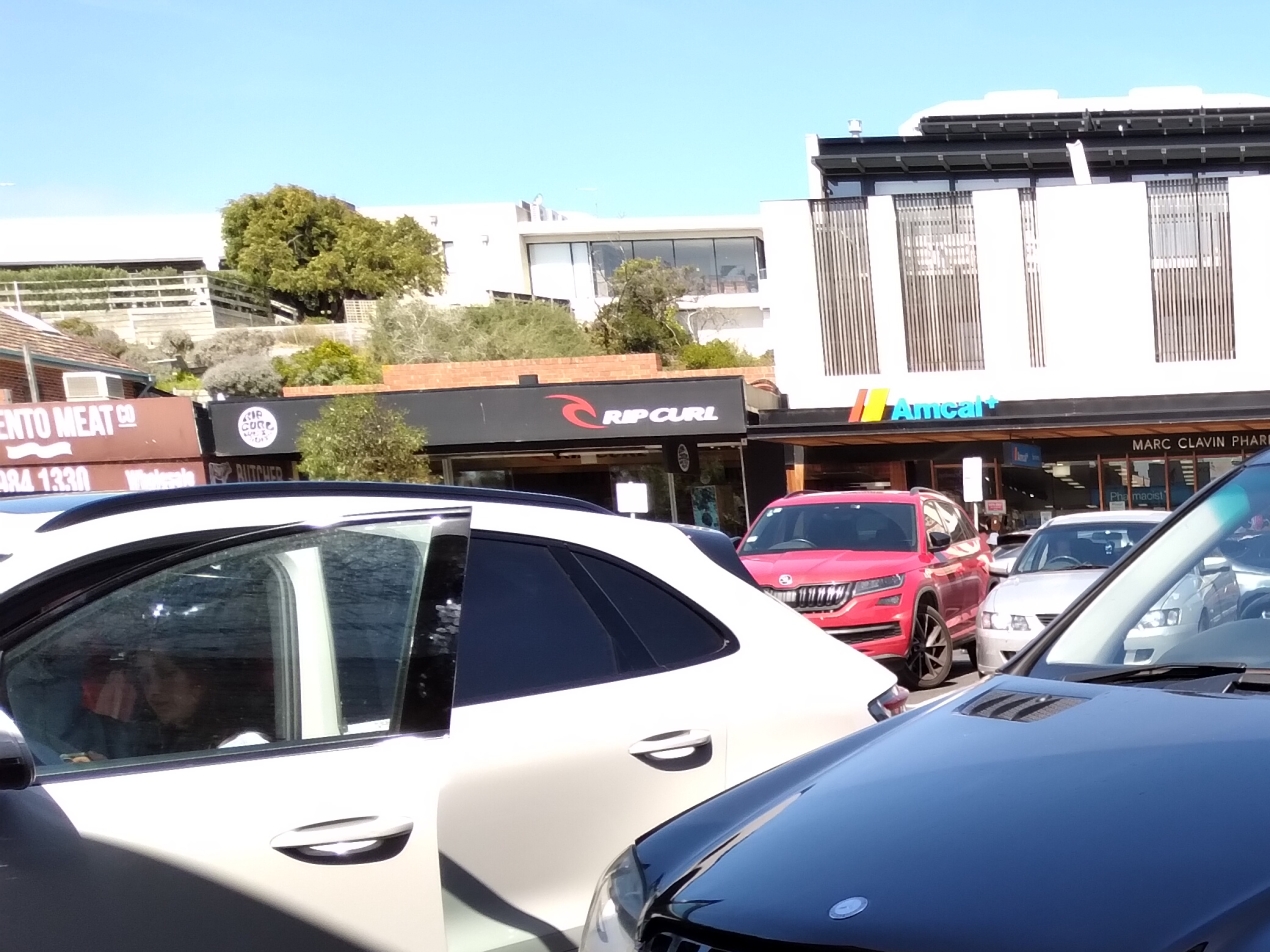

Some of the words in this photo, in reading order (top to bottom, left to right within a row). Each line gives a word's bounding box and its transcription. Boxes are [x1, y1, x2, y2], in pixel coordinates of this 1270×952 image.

[52, 405, 114, 437] MEAT
[602, 408, 649, 425] RIP
[649, 406, 719, 423] CURL
[1132, 438, 1171, 450] MARC
[1177, 435, 1225, 449] CLAVIN
[1110, 491, 1163, 501] Phamacist
